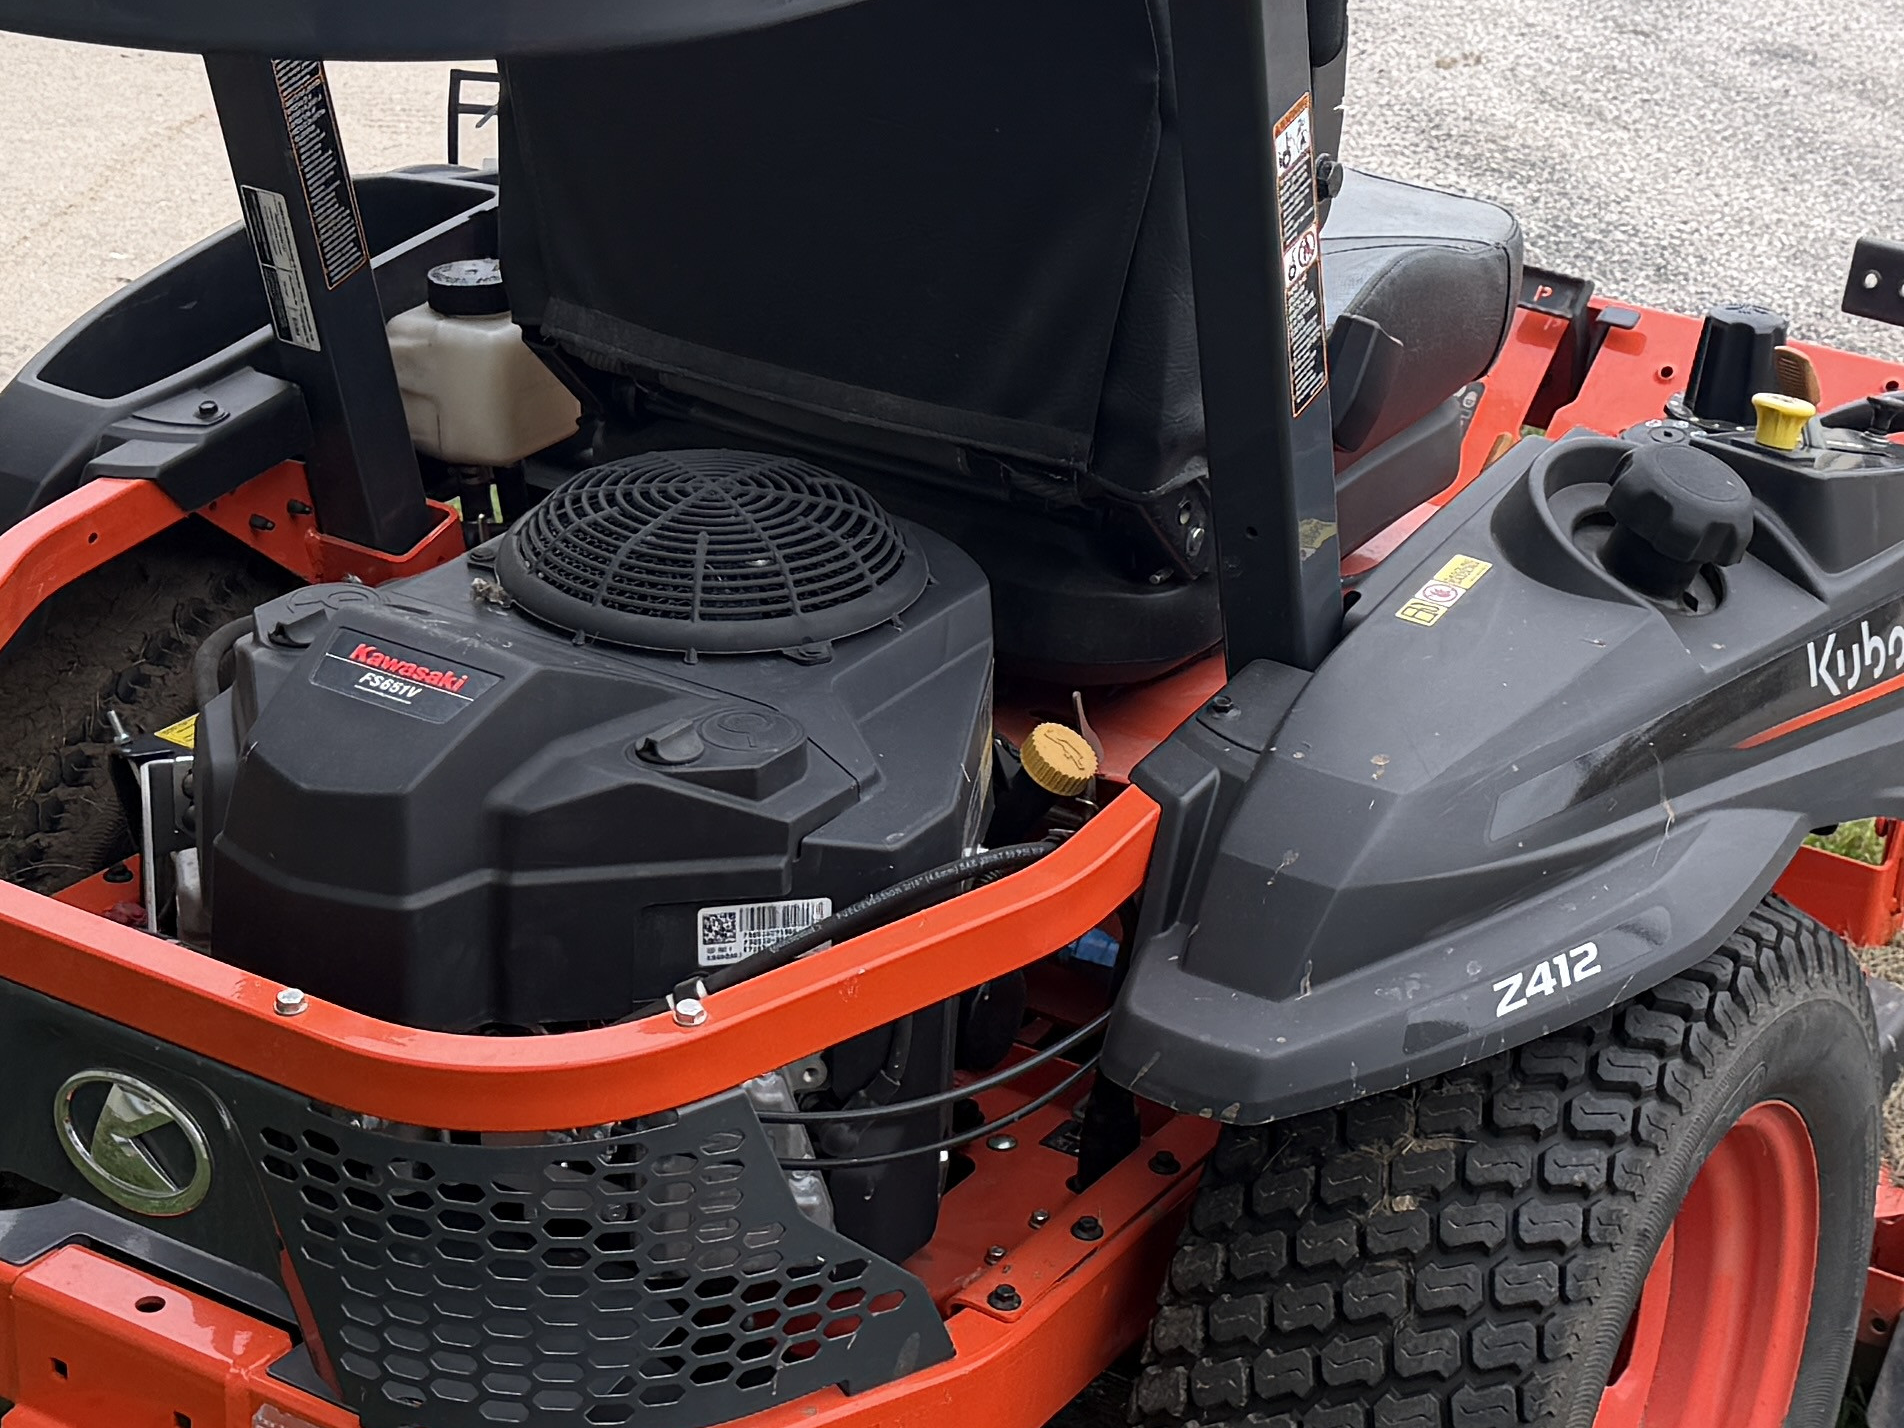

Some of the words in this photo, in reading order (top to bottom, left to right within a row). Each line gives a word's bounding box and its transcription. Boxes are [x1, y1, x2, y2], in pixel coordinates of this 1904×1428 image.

[1533, 285, 1553, 303] P
[349, 643, 469, 692] Kawasaki
[358, 672, 423, 698] FS651V
[1492, 941, 1602, 1018] Z412
